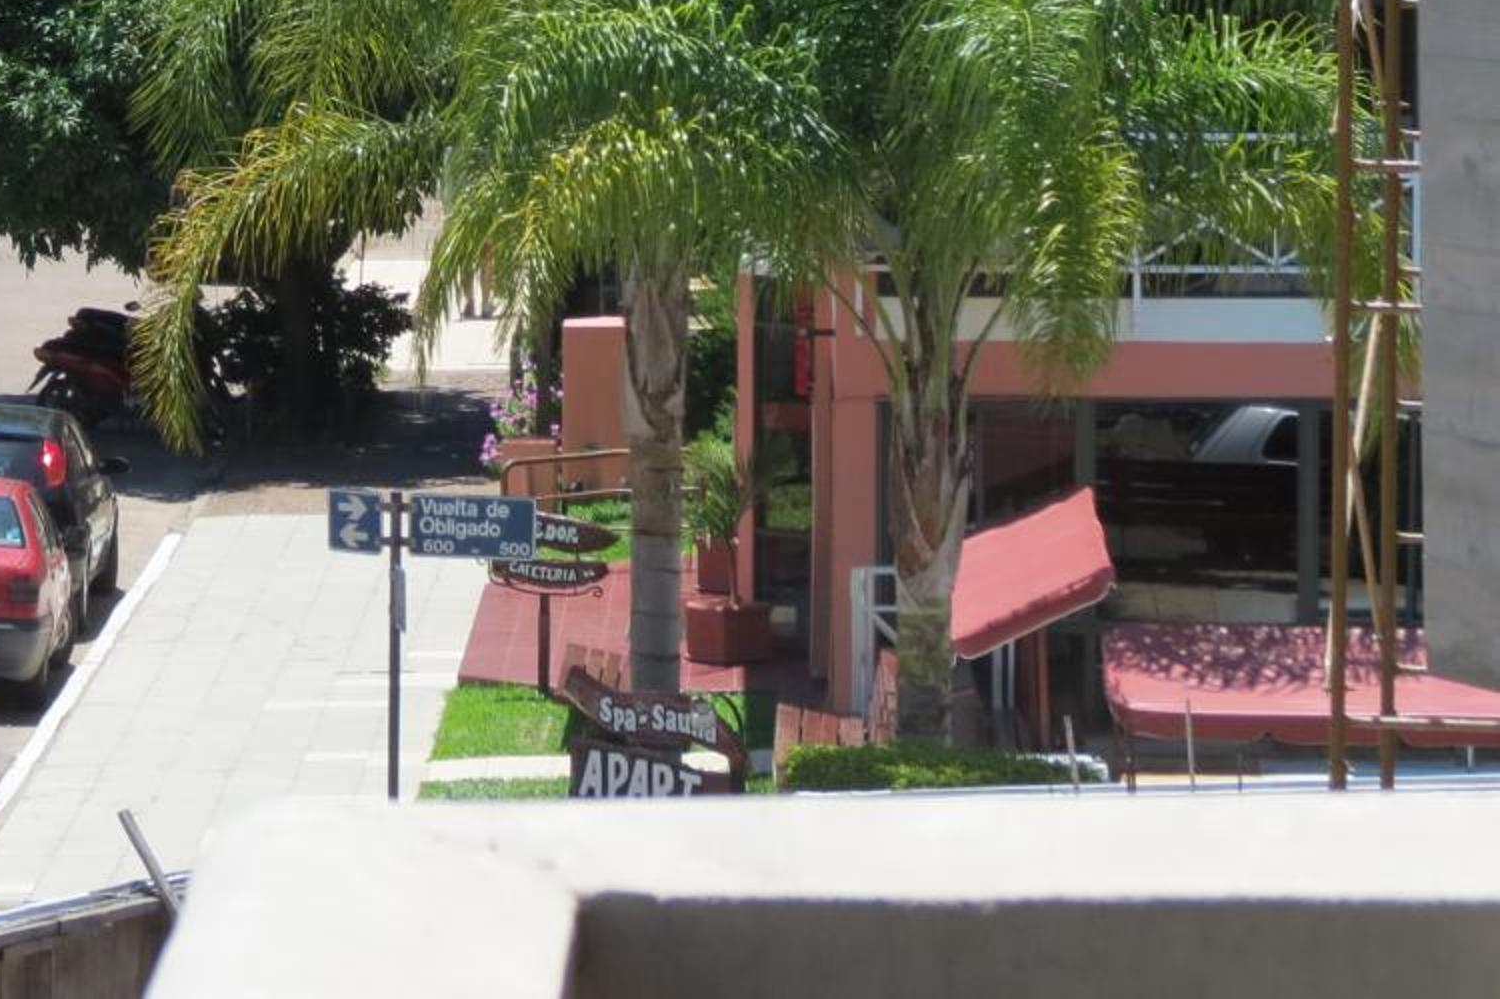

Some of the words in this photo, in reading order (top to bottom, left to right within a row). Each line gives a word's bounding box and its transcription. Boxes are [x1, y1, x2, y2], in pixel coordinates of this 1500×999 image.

[420, 497, 478, 518] Vuelta
[486, 500, 510, 518] de
[419, 515, 501, 540] Obligado
[423, 539, 454, 554] 600
[499, 541, 531, 556] 500
[509, 561, 577, 582] CAFETERIA
